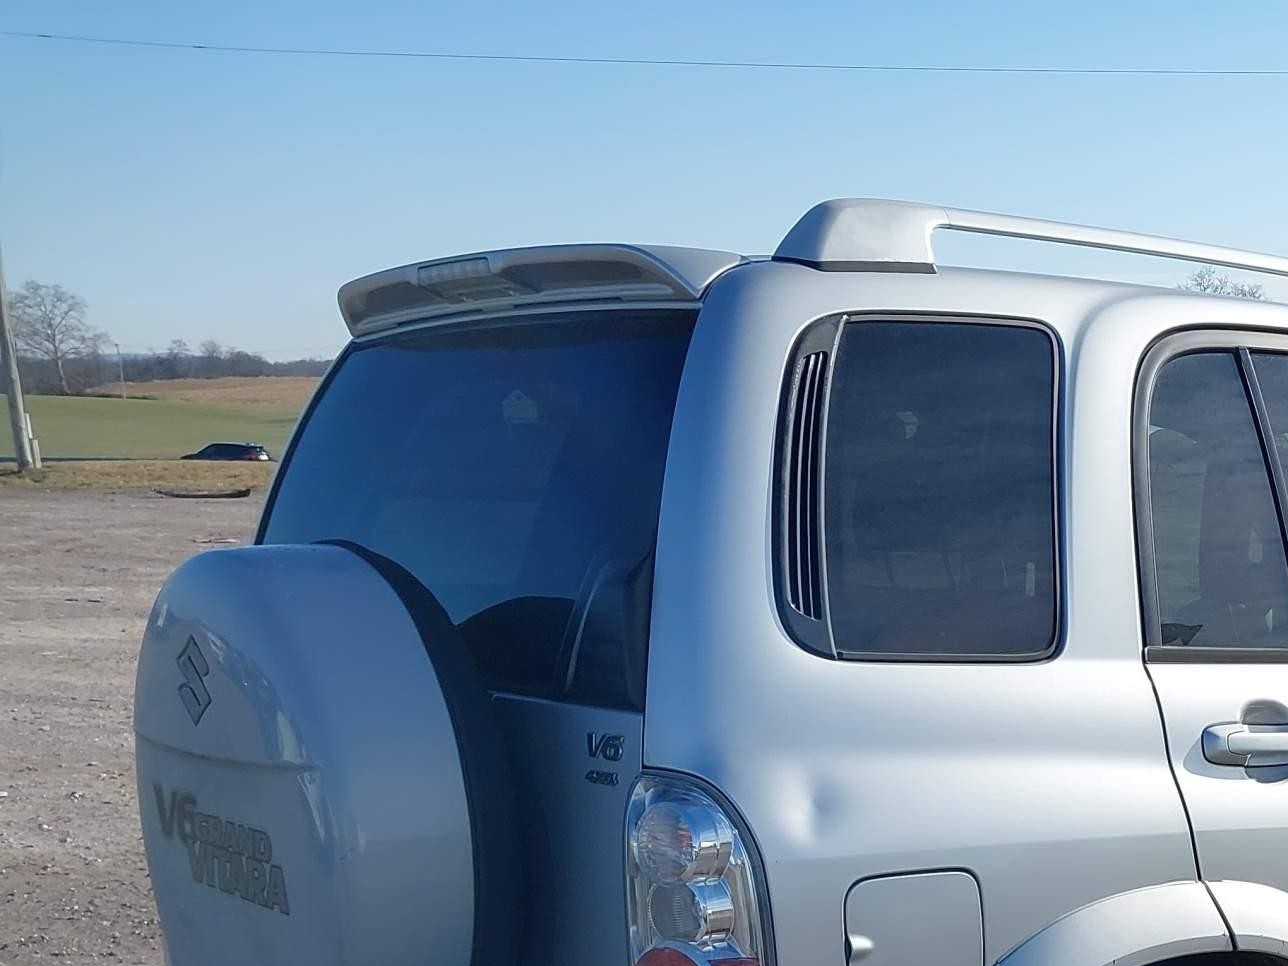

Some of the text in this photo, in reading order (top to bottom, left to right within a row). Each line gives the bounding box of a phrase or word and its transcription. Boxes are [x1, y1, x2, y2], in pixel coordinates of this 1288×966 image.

[586, 732, 624, 761] V6
[153, 783, 272, 864] V6 GRAND
[186, 840, 290, 916] VITARA
